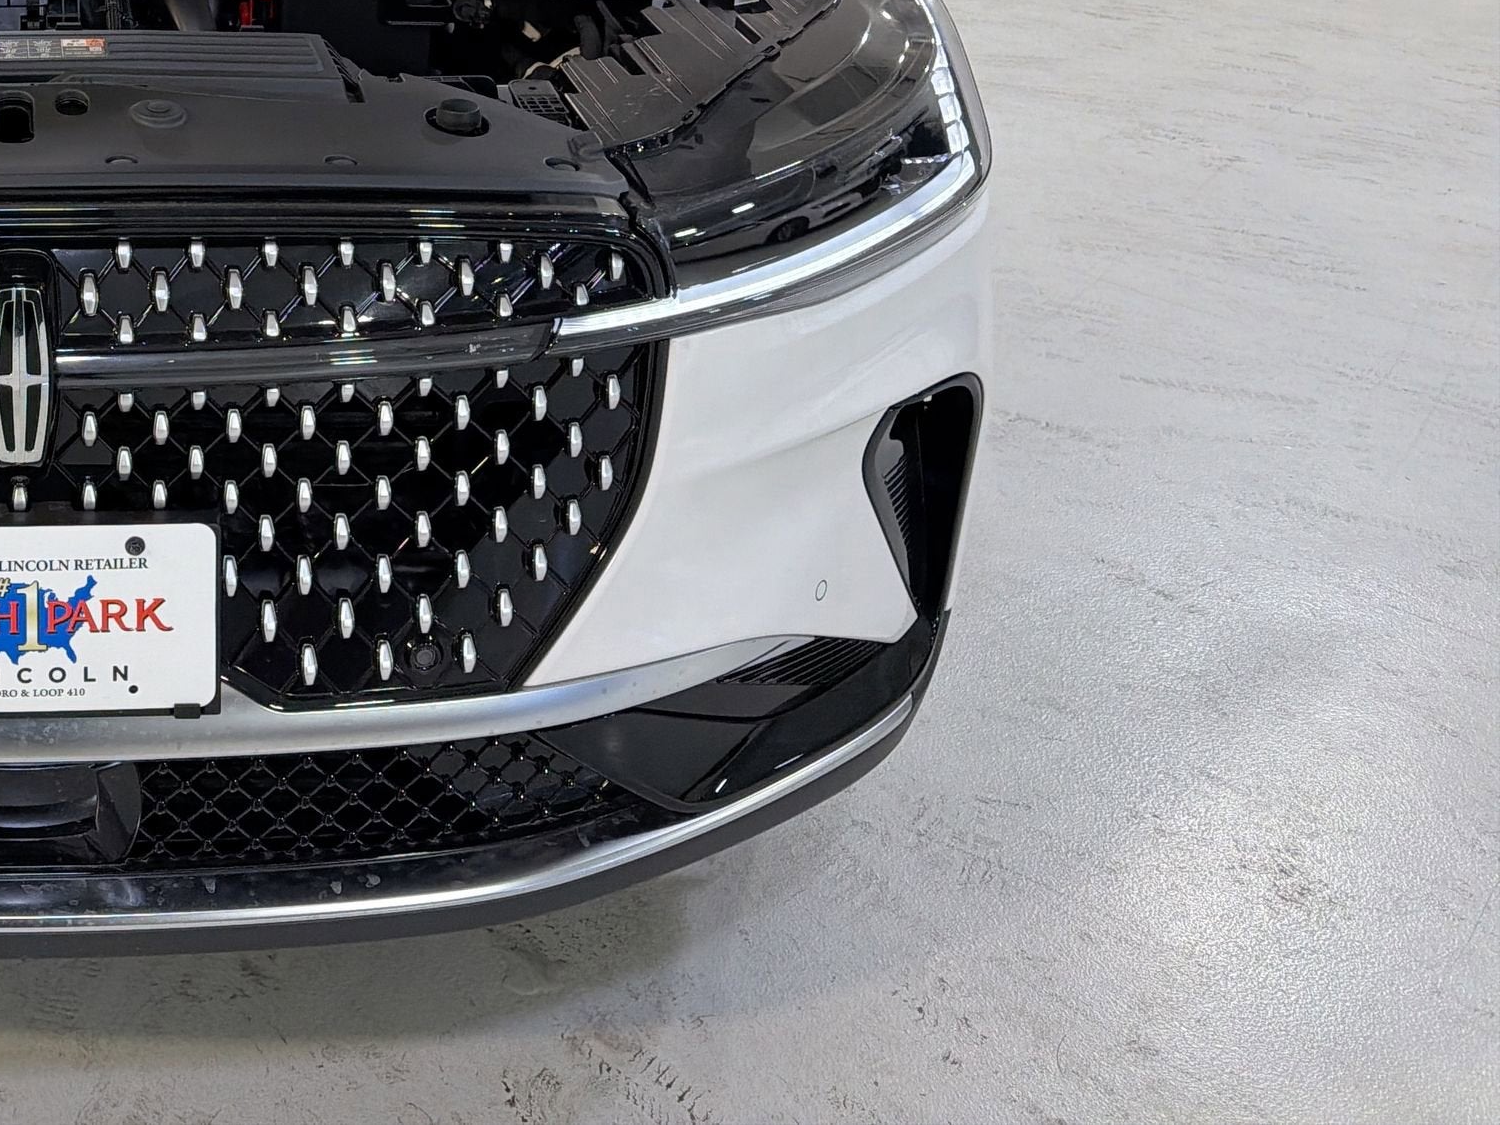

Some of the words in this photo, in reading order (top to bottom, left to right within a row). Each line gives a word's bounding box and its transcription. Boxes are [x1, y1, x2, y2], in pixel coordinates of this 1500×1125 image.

[74, 557, 148, 571] RETAILER
[47, 598, 174, 633] PARK
[20, 689, 30, 697] &
[33, 688, 64, 697] LOOP
[67, 687, 86, 697] 410
